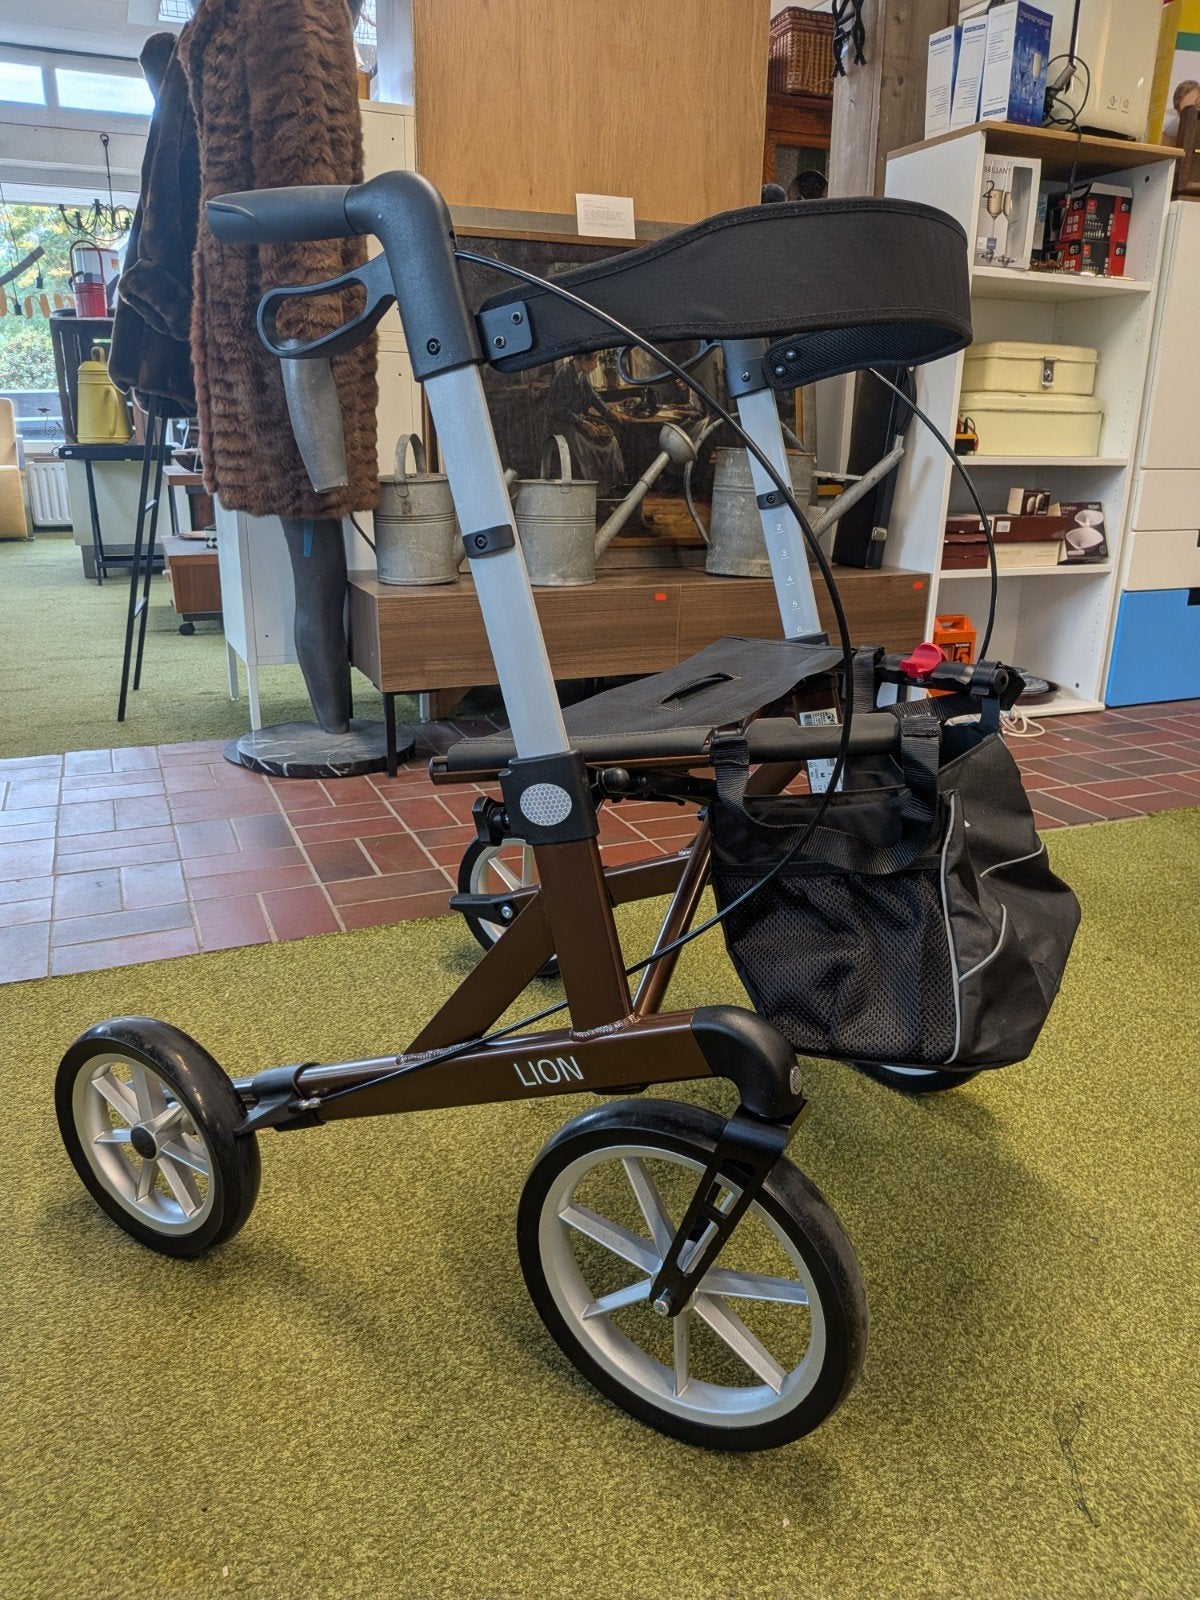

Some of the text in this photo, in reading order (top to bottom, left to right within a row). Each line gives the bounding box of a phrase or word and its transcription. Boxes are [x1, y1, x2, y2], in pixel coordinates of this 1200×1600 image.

[984, 165, 1011, 175] BRILLANT
[776, 523, 782, 531] 2
[781, 549, 787, 557] 3
[513, 1056, 585, 1087] LION
